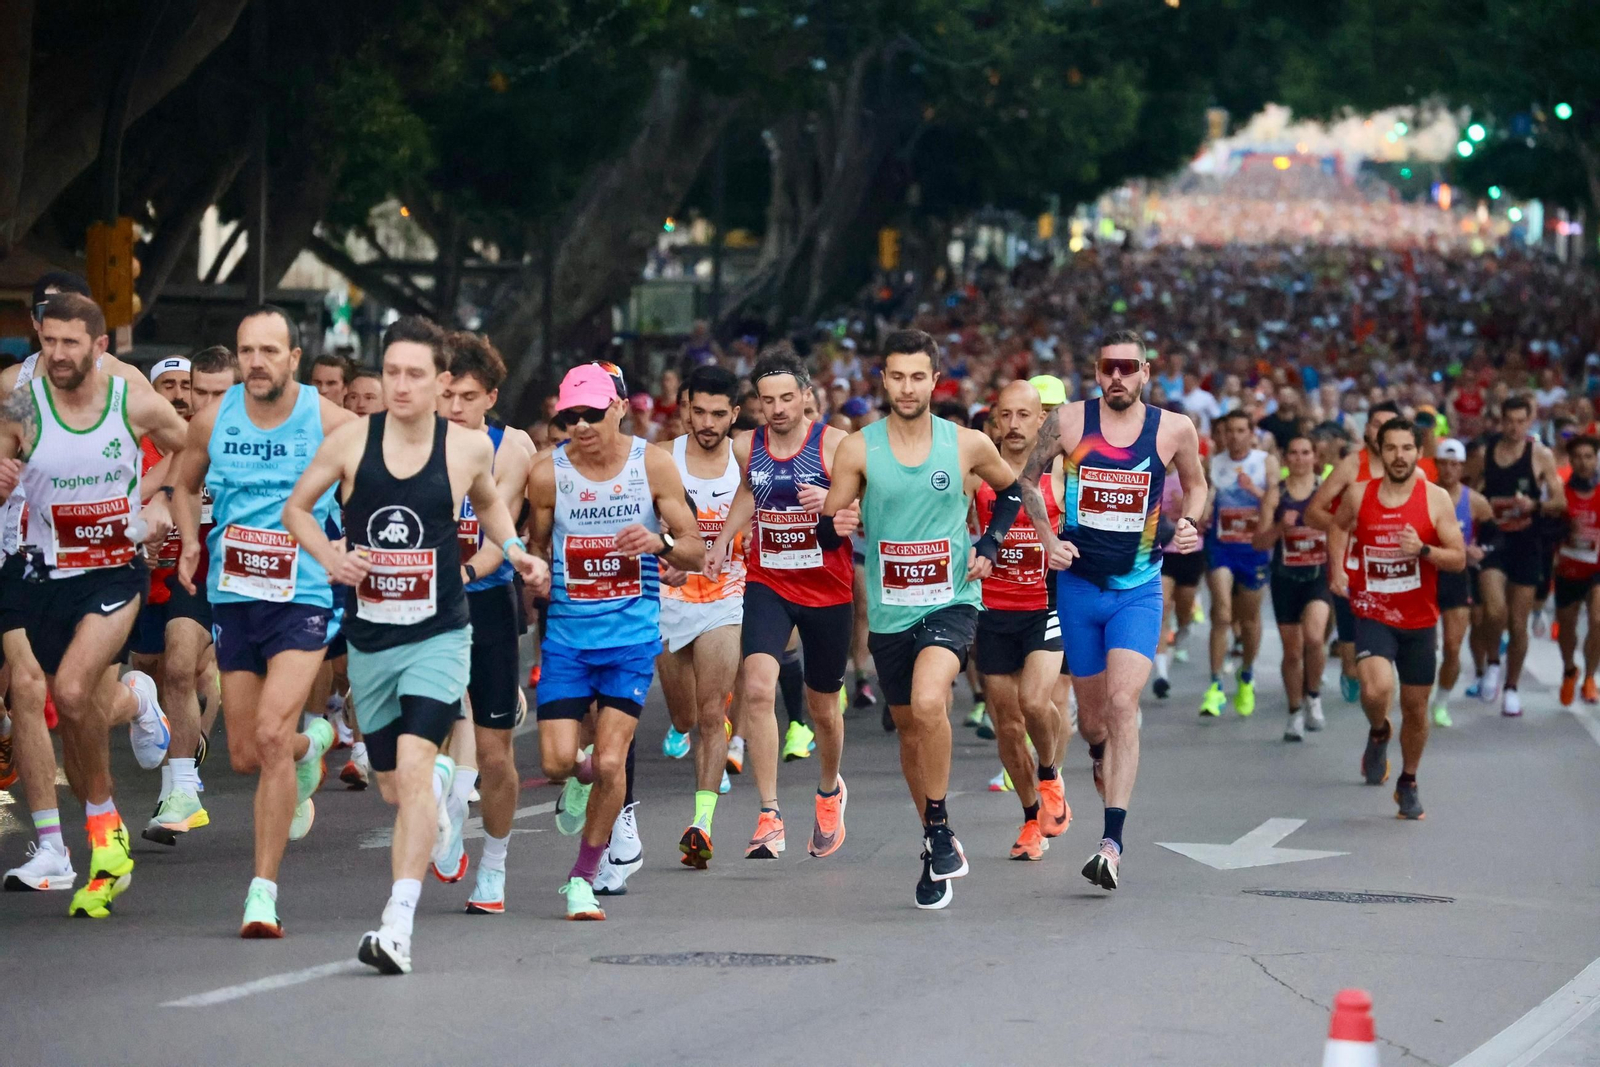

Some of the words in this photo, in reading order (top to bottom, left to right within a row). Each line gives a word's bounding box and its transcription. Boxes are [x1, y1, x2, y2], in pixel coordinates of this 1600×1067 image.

[223, 439, 288, 461] nerja
[51, 474, 100, 490] Togher
[104, 469, 122, 482] AC
[1099, 472, 1145, 484] GENERALI
[1093, 490, 1134, 505] 13598
[73, 500, 125, 516] GENERALI
[569, 503, 641, 520] MARACENA
[770, 513, 813, 523] GENERALI
[75, 524, 114, 538] 6024
[769, 532, 806, 543] 13399
[896, 542, 945, 555] GENERALI
[1001, 548, 1024, 559] 255
[236, 551, 279, 570] 13862
[373, 553, 428, 565] GENERALI
[583, 558, 621, 571] 6168
[894, 564, 936, 577] 17672
[369, 575, 417, 592] 15057
